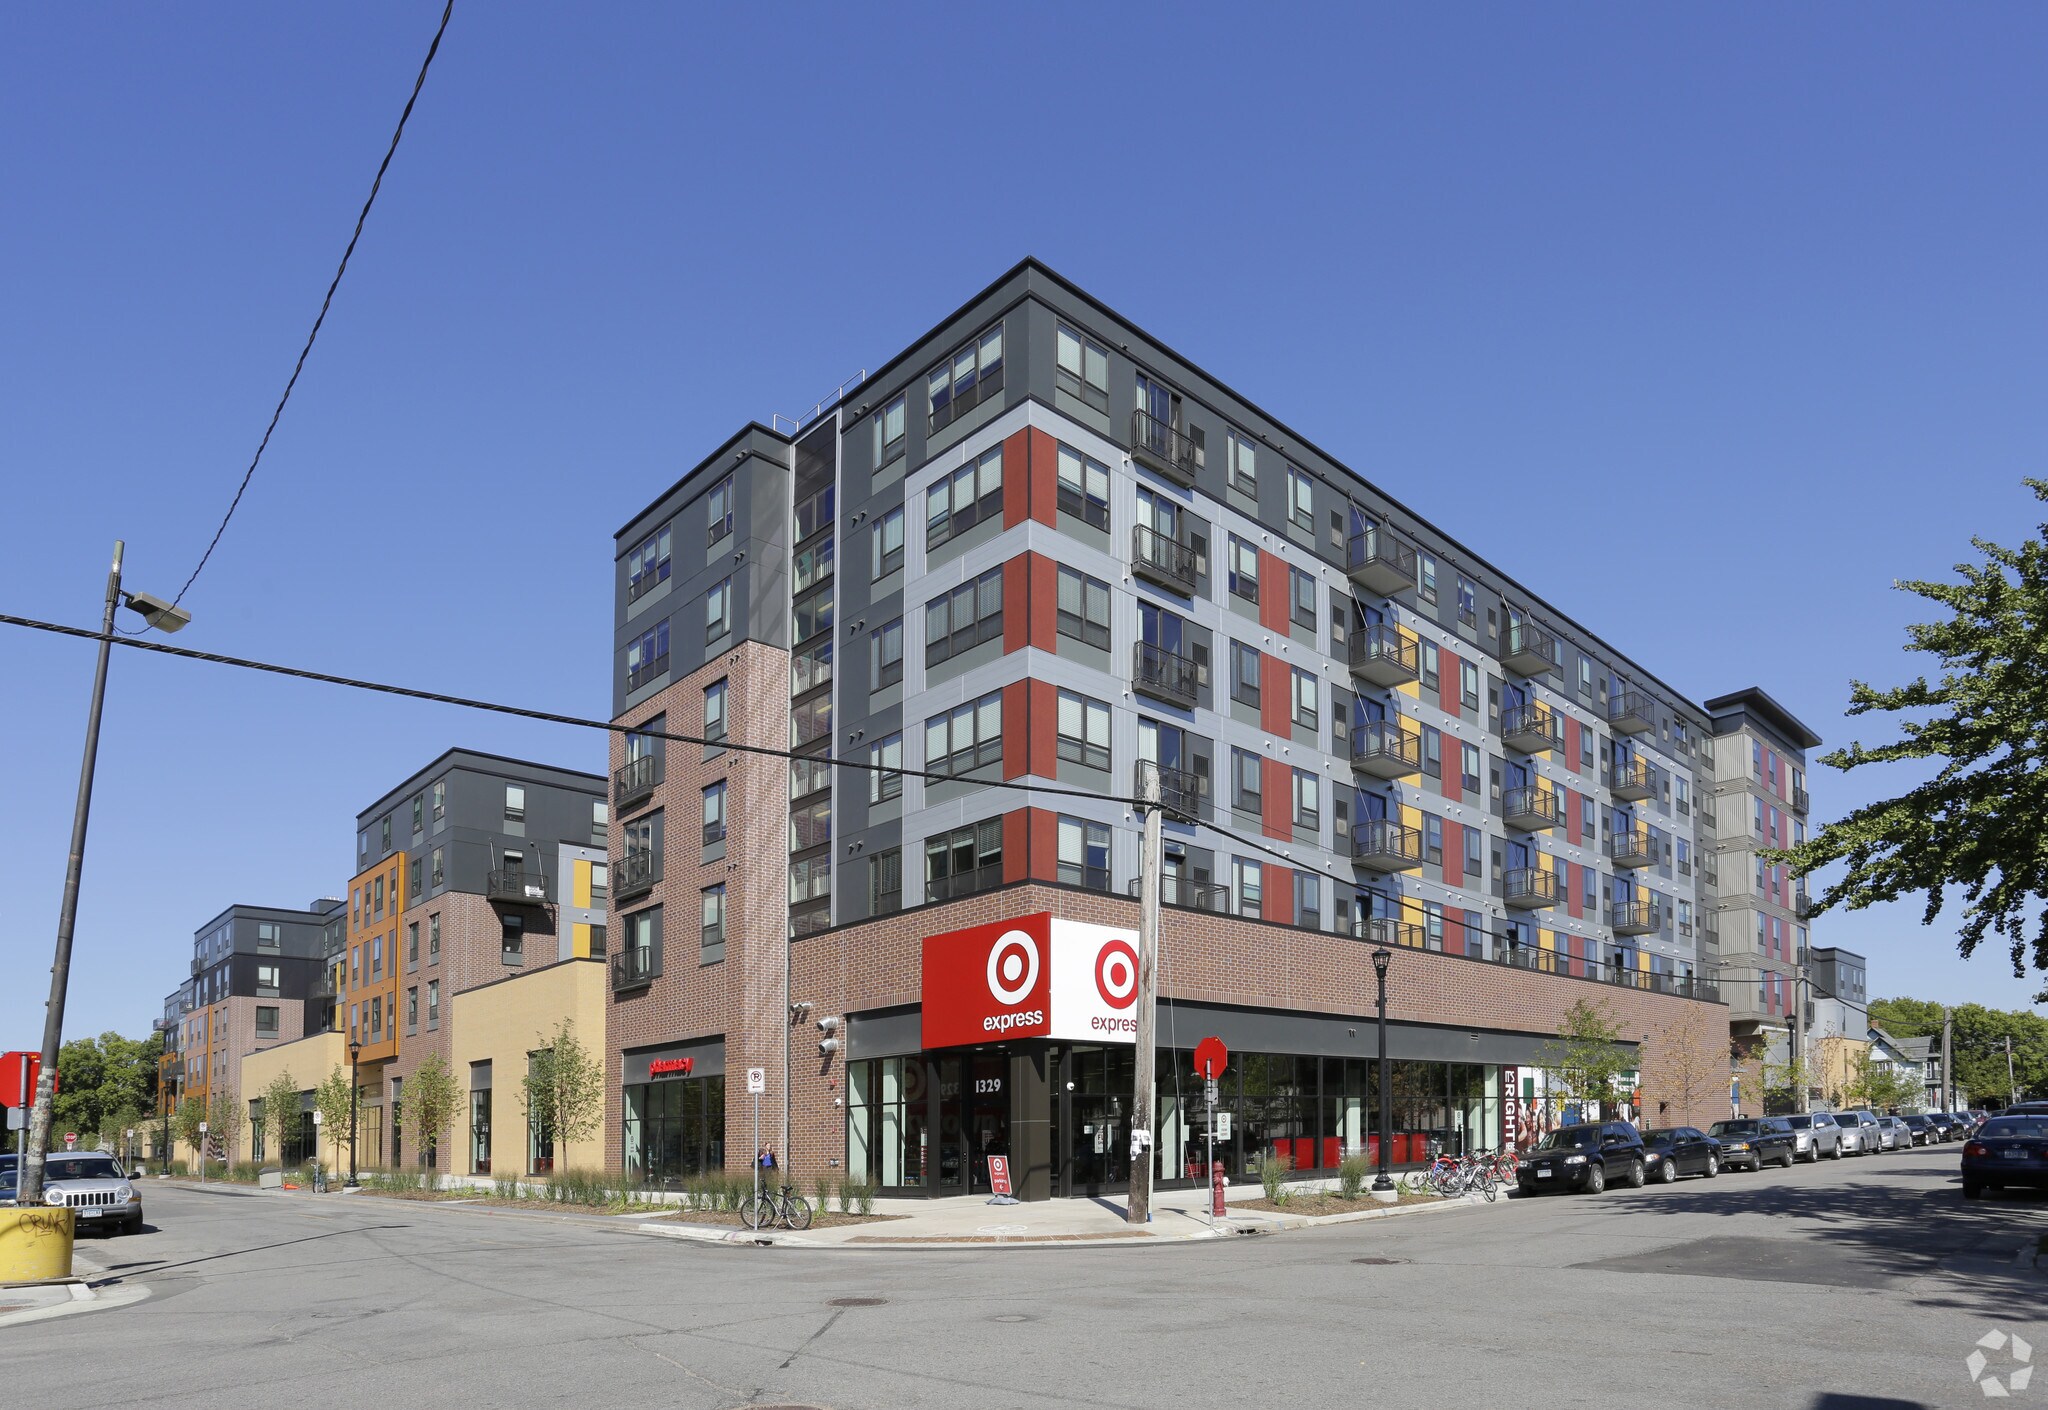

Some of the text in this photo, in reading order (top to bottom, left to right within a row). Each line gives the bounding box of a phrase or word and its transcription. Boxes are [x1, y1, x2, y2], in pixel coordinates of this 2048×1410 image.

[983, 1010, 1043, 1033] express
[1091, 1016, 1137, 1034] expres
[975, 1079, 1001, 1093] 1329
[1505, 1084, 1515, 1141] RIGHT
